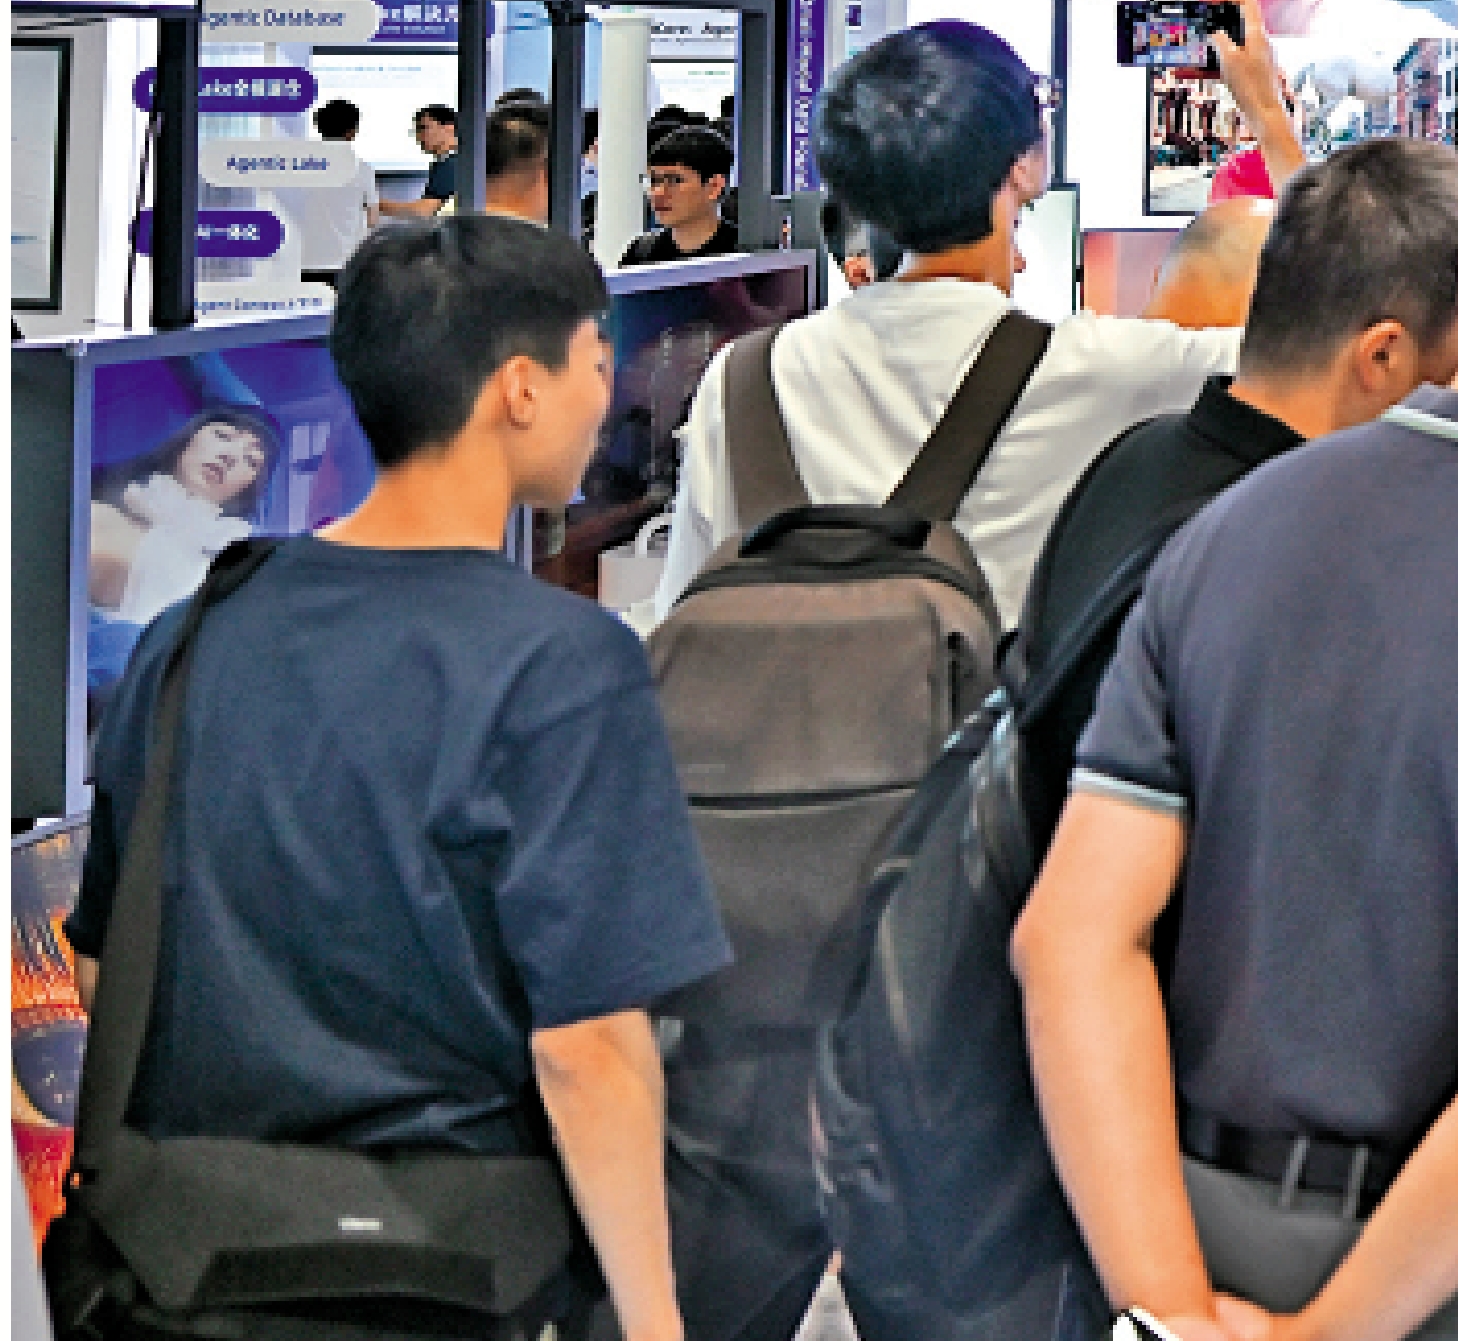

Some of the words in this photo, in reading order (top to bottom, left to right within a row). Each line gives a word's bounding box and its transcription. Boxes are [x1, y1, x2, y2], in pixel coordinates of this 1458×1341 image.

[264, 7, 347, 27] Database
[226, 154, 287, 175] Agentic
[292, 154, 331, 171] Lake
